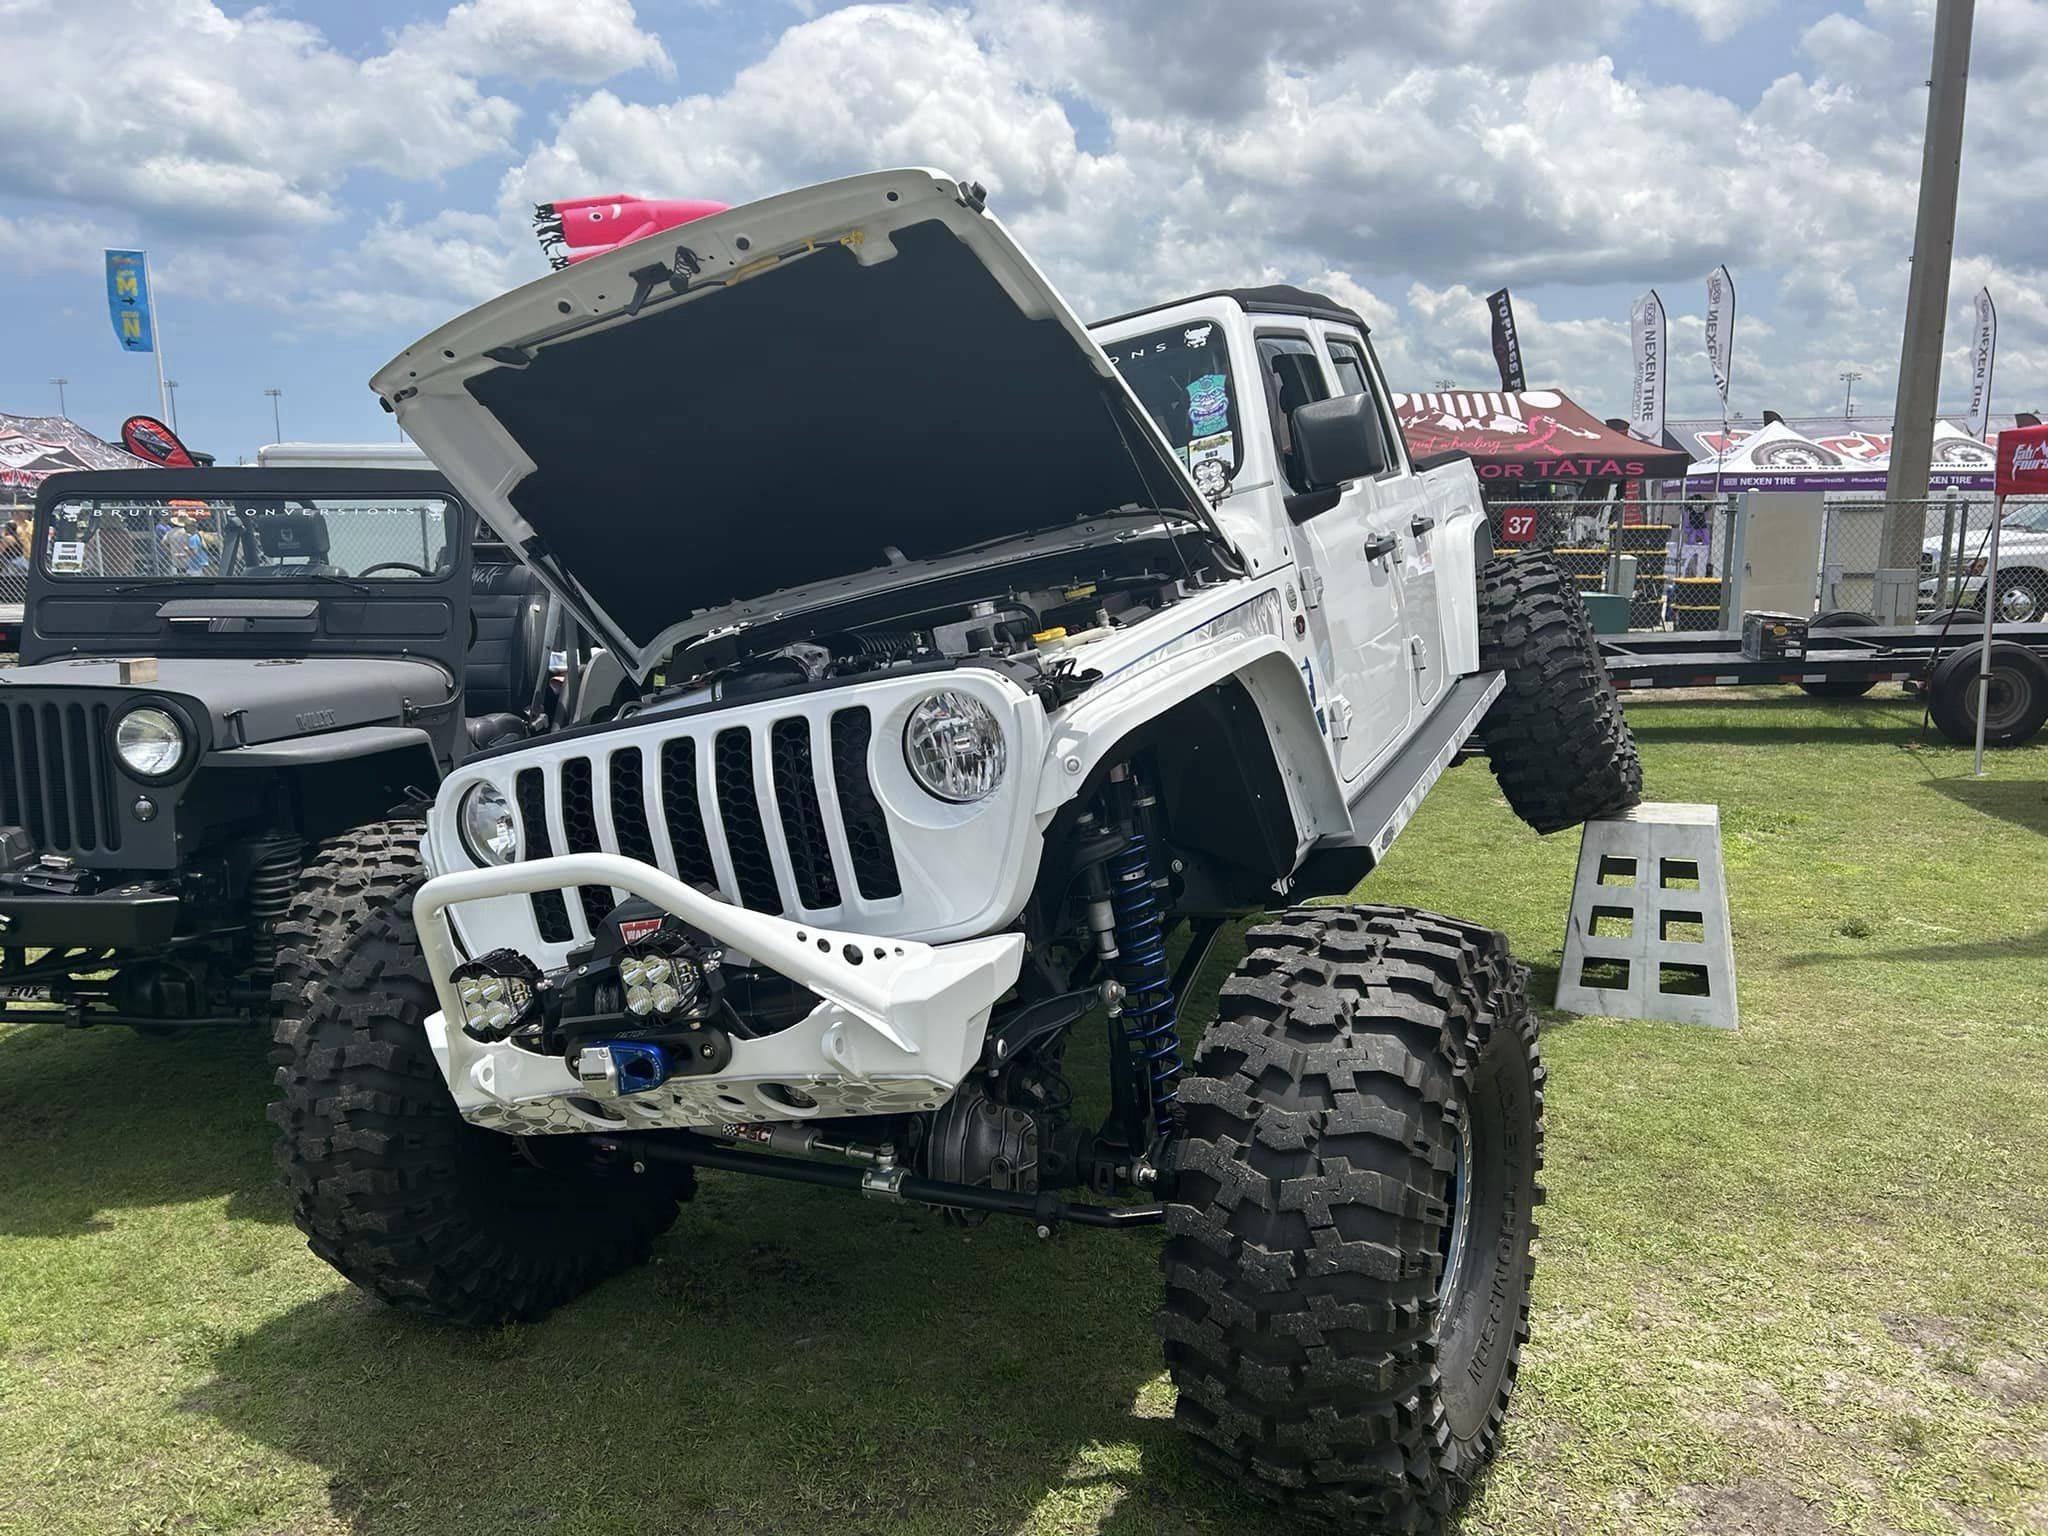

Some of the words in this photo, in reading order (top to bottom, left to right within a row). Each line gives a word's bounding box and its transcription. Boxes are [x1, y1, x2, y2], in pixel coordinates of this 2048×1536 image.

[1498, 294, 1519, 374] TOPLESS
[1644, 330, 1656, 382] NEXEN
[1977, 327, 1991, 379] NEXEN
[1642, 385, 1655, 422] TIRE
[1970, 382, 1984, 417] TIRE
[1474, 463, 1524, 478] OR
[1532, 458, 1645, 476] TATAS
[1740, 477, 1772, 486] NEXEN
[1774, 477, 1796, 485] TIRE
[1951, 476, 1972, 484] TIRE
[94, 509, 206, 517] BRUISER
[227, 508, 415, 516] CONVERSIONS
[1508, 516, 1533, 534] 37
[626, 928, 655, 940] WAR
